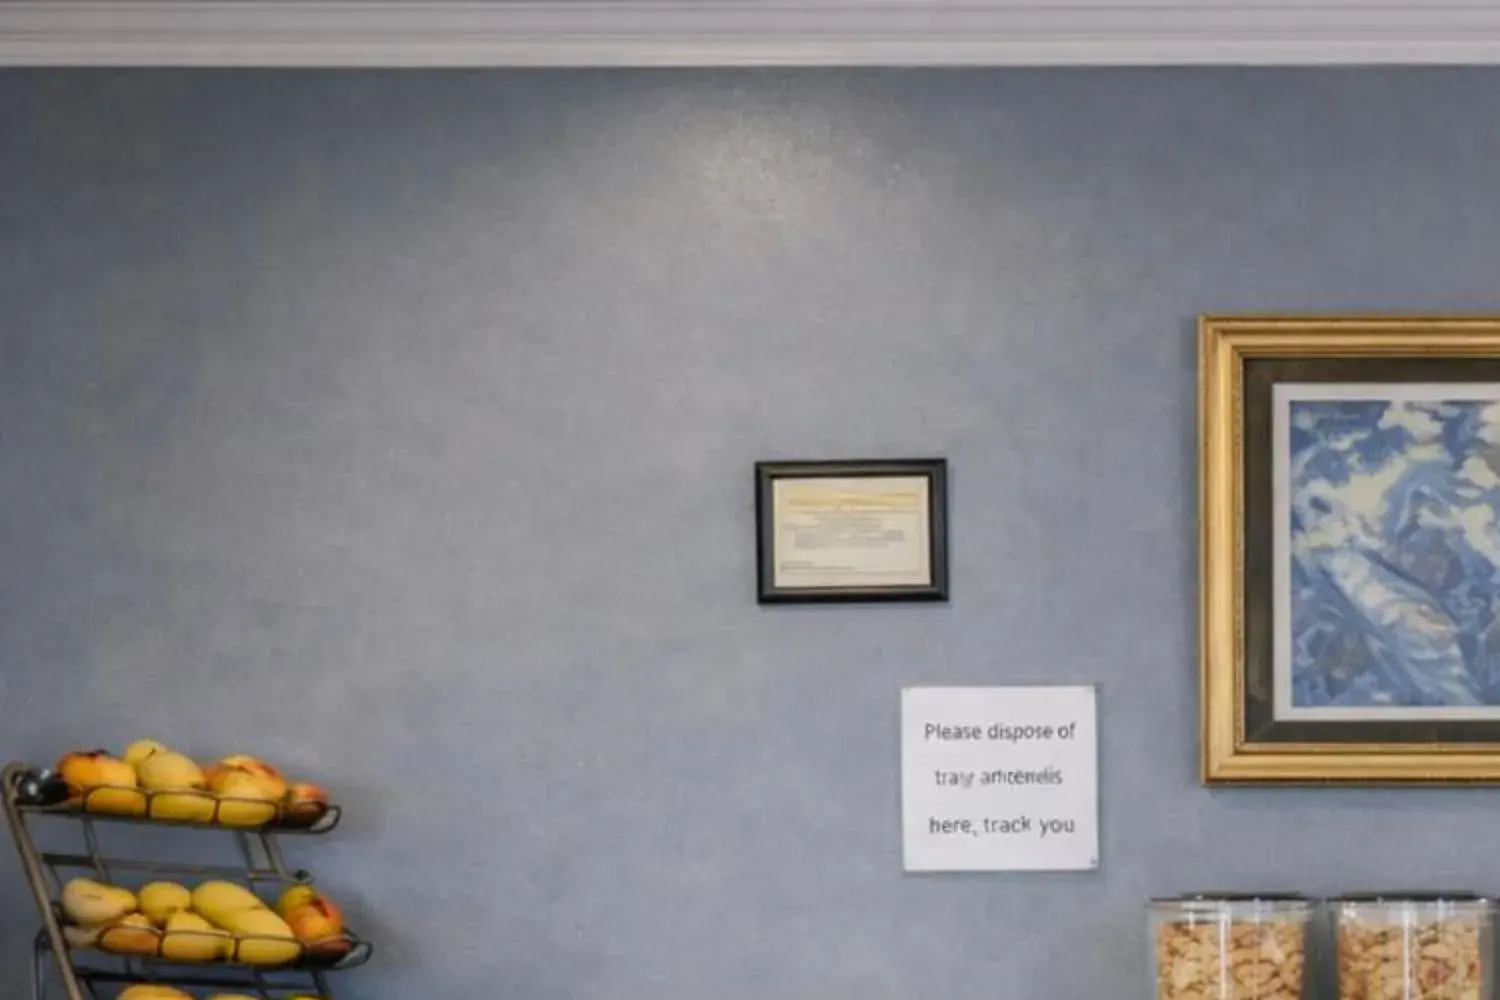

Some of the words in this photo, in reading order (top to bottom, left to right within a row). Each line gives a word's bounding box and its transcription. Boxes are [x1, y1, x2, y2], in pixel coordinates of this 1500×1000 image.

[925, 722, 981, 740] Please
[987, 722, 1053, 743] dispose
[1057, 722, 1075, 739] of
[928, 817, 978, 838] here,
[983, 816, 1031, 834] track
[1039, 819, 1075, 838] you
